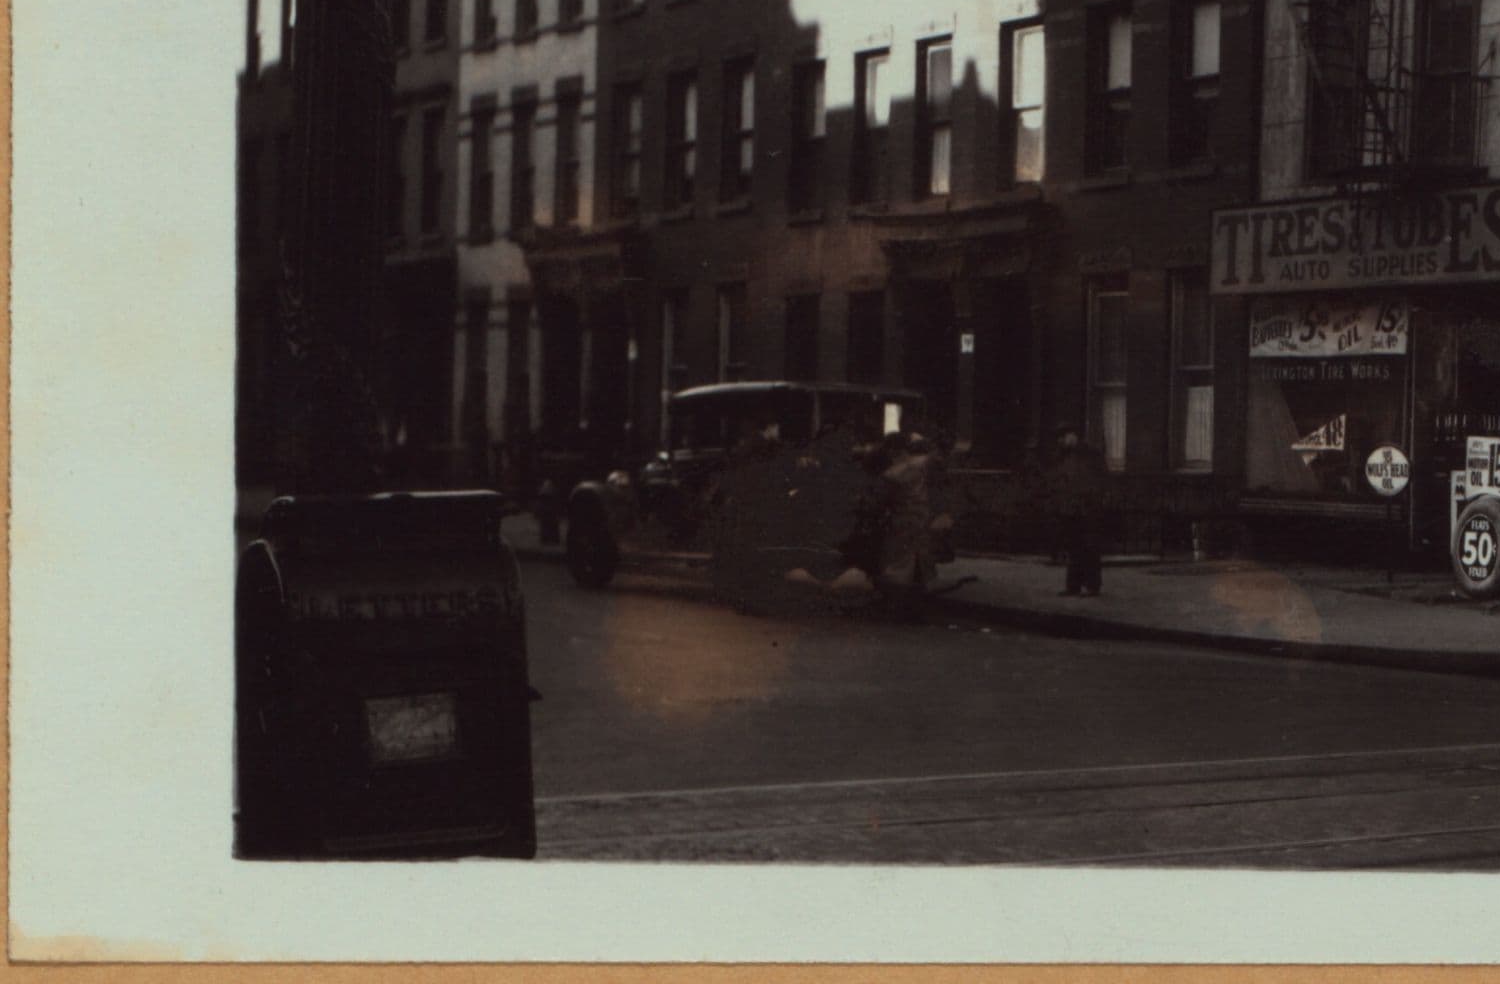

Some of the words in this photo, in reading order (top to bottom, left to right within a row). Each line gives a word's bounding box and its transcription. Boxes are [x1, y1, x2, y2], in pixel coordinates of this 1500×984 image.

[1216, 207, 1346, 284] TIRES
[1279, 260, 1330, 281] AUTO
[1347, 252, 1438, 278] SUPPLIES
[1338, 325, 1362, 351] OIL
[1351, 361, 1391, 380] WORKS
[1382, 478, 1394, 489] OIL
[1471, 471, 1483, 487] OIL
